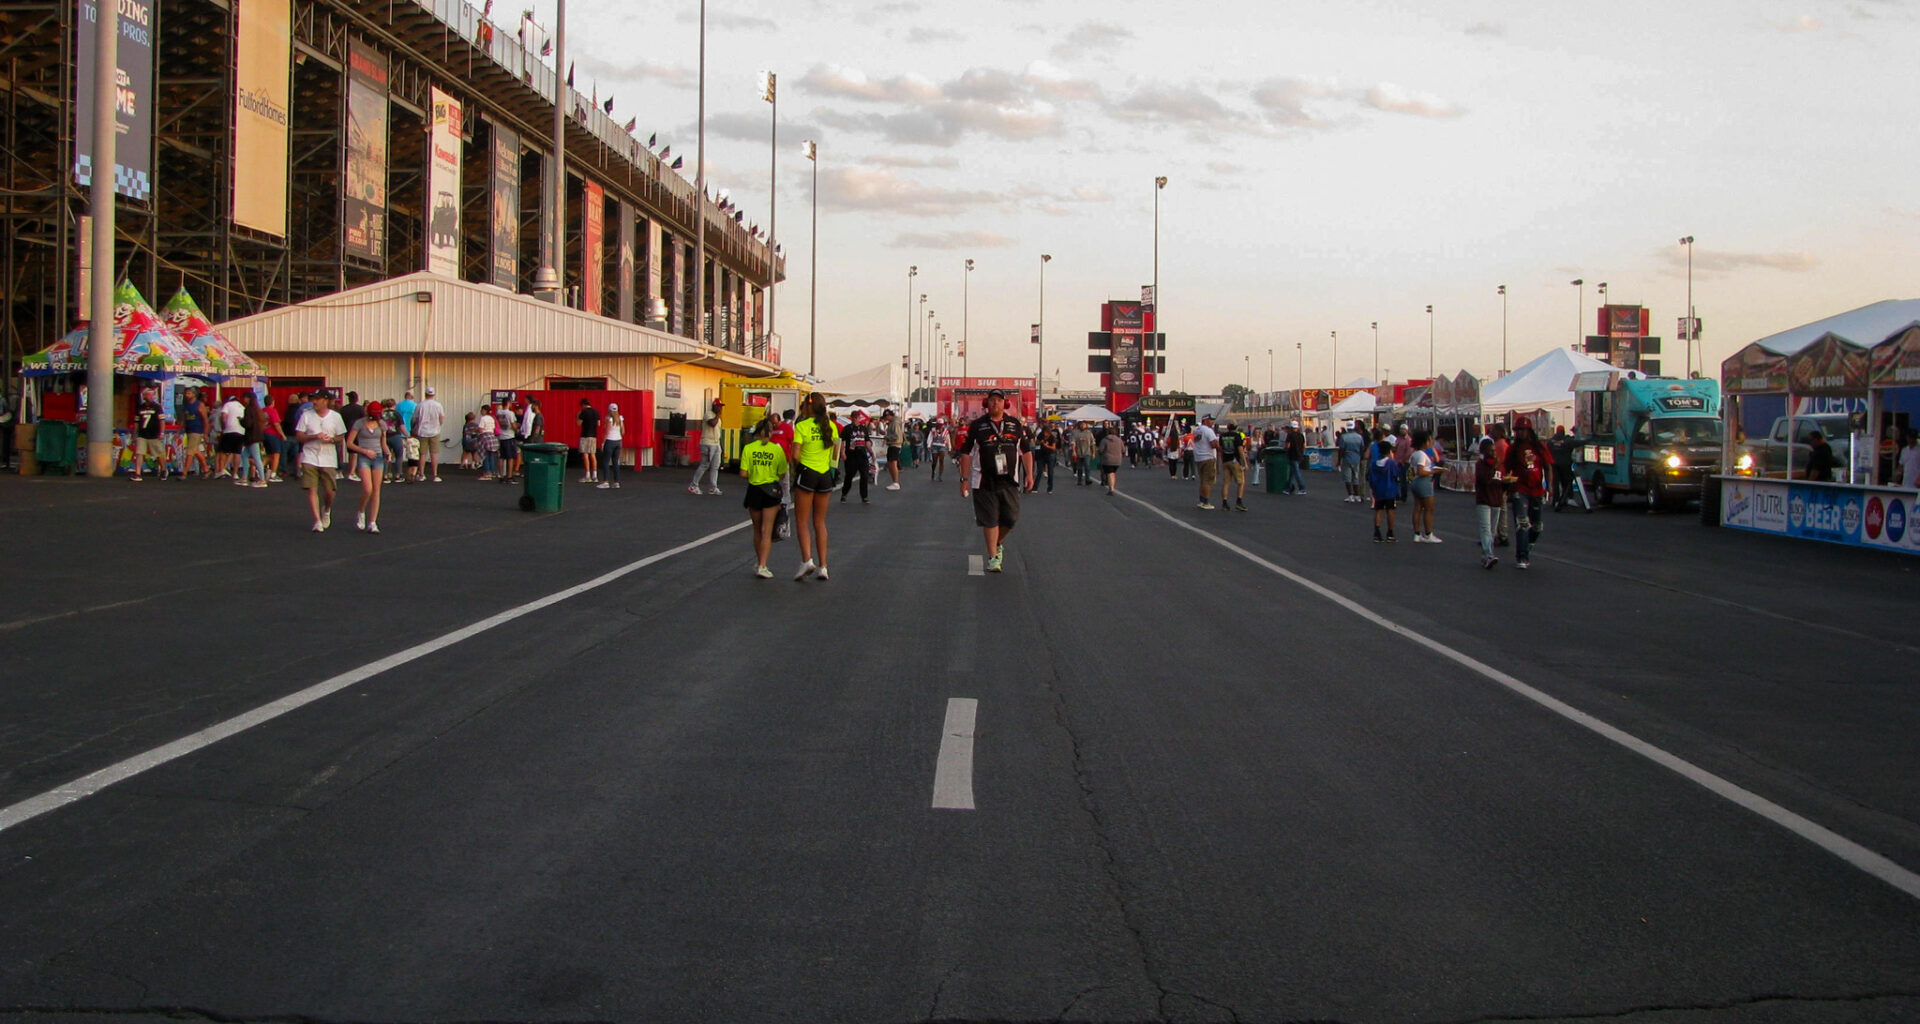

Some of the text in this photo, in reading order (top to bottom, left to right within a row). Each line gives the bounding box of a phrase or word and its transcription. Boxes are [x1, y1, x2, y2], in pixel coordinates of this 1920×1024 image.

[84, 3, 150, 47] TO PROS.
[239, 87, 286, 126] FulfordHomes
[30, 362, 49, 370] WE
[52, 362, 88, 370] REFILL
[128, 363, 160, 372] HERE
[941, 379, 961, 387] SIUE
[977, 379, 998, 387] SIUE
[1303, 390, 1336, 398] COD
[1147, 398, 1187, 407] The Pub
[143, 414, 151, 429] 7
[752, 451, 774, 460] 50/50
[1806, 503, 1840, 531] BEER
